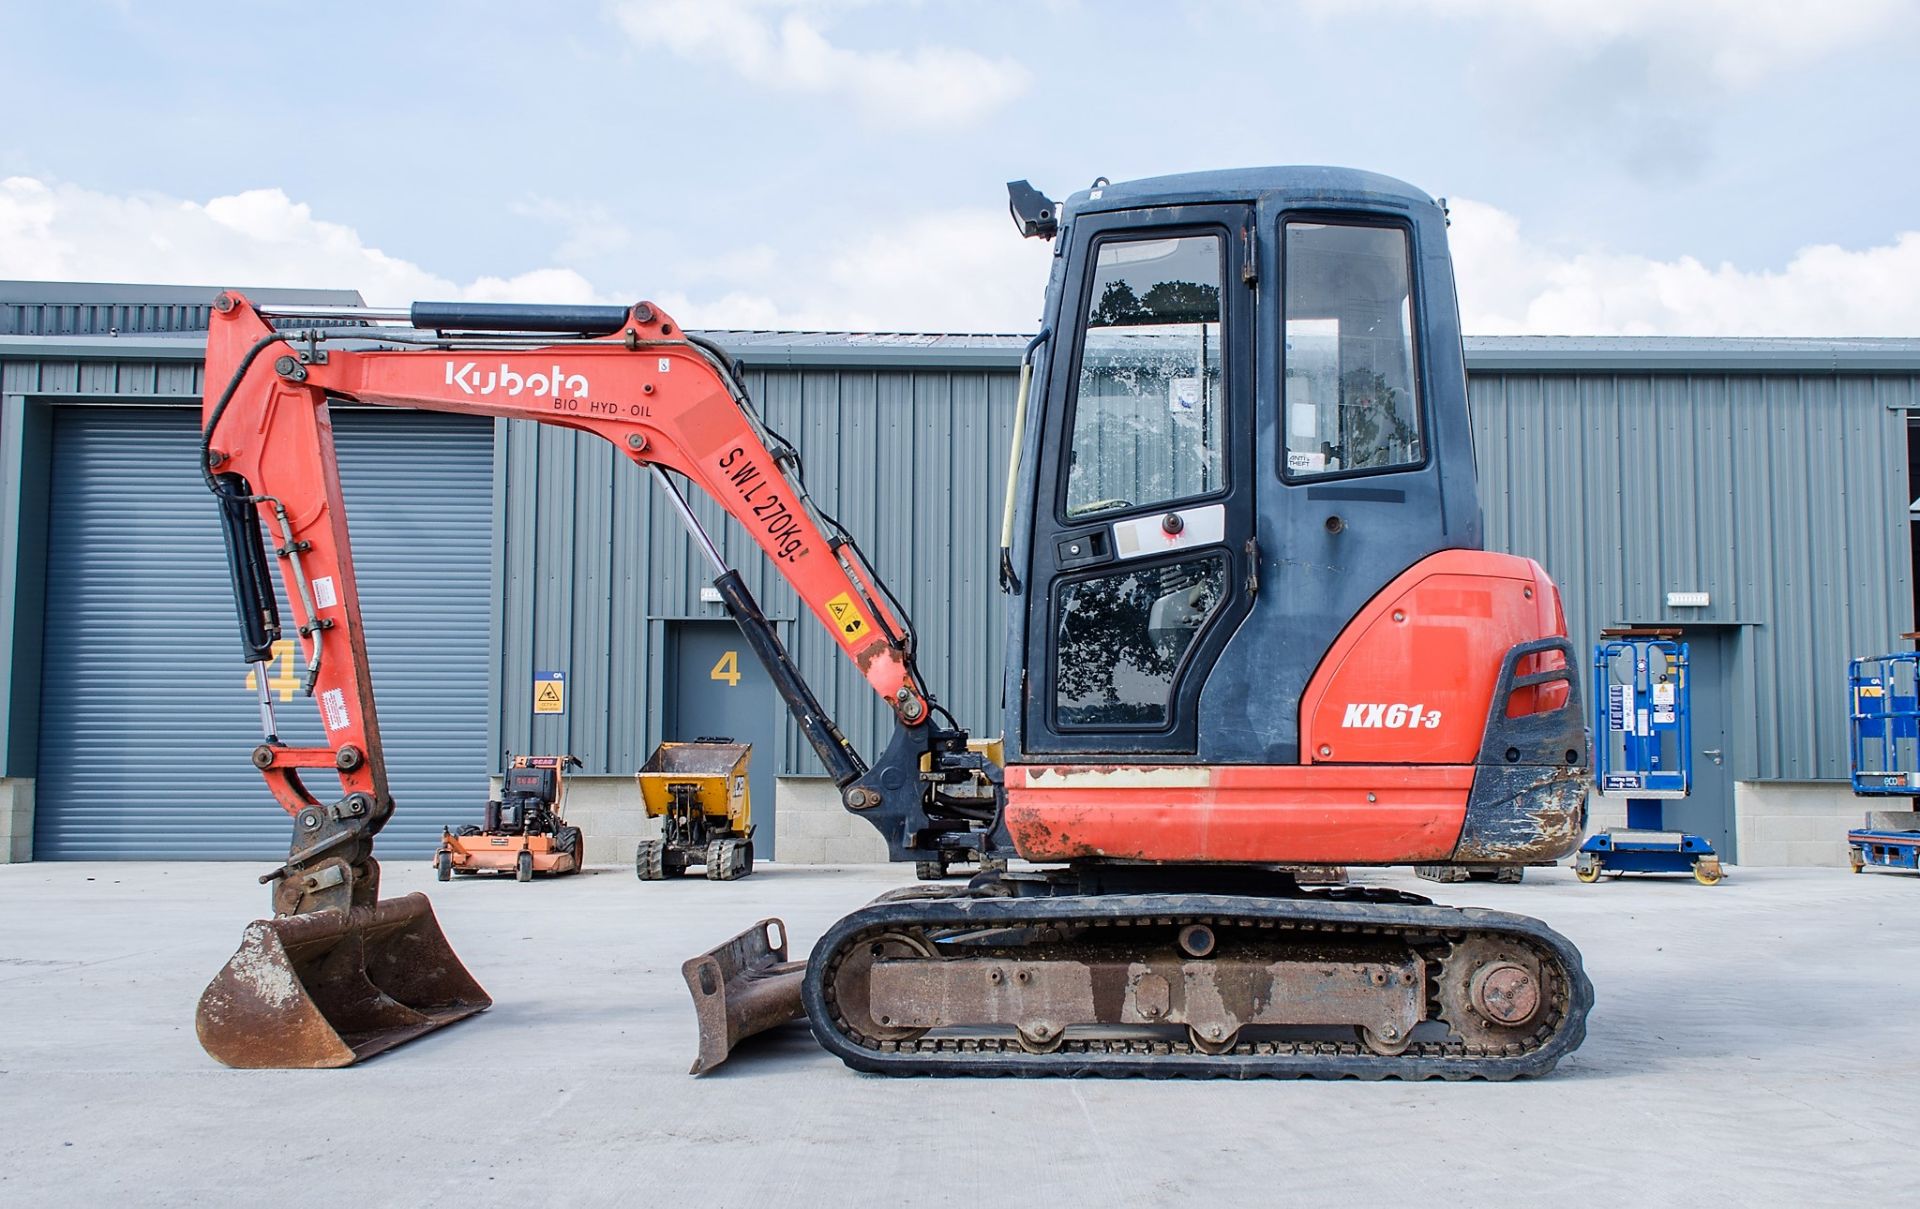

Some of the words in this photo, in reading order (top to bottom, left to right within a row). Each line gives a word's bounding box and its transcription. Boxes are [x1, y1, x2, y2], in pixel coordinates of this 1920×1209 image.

[445, 361, 589, 397] Kubota
[554, 398, 578, 411] BIO
[245, 640, 300, 702] 4
[711, 651, 741, 687] 4
[1341, 703, 1442, 729] KX61-3
